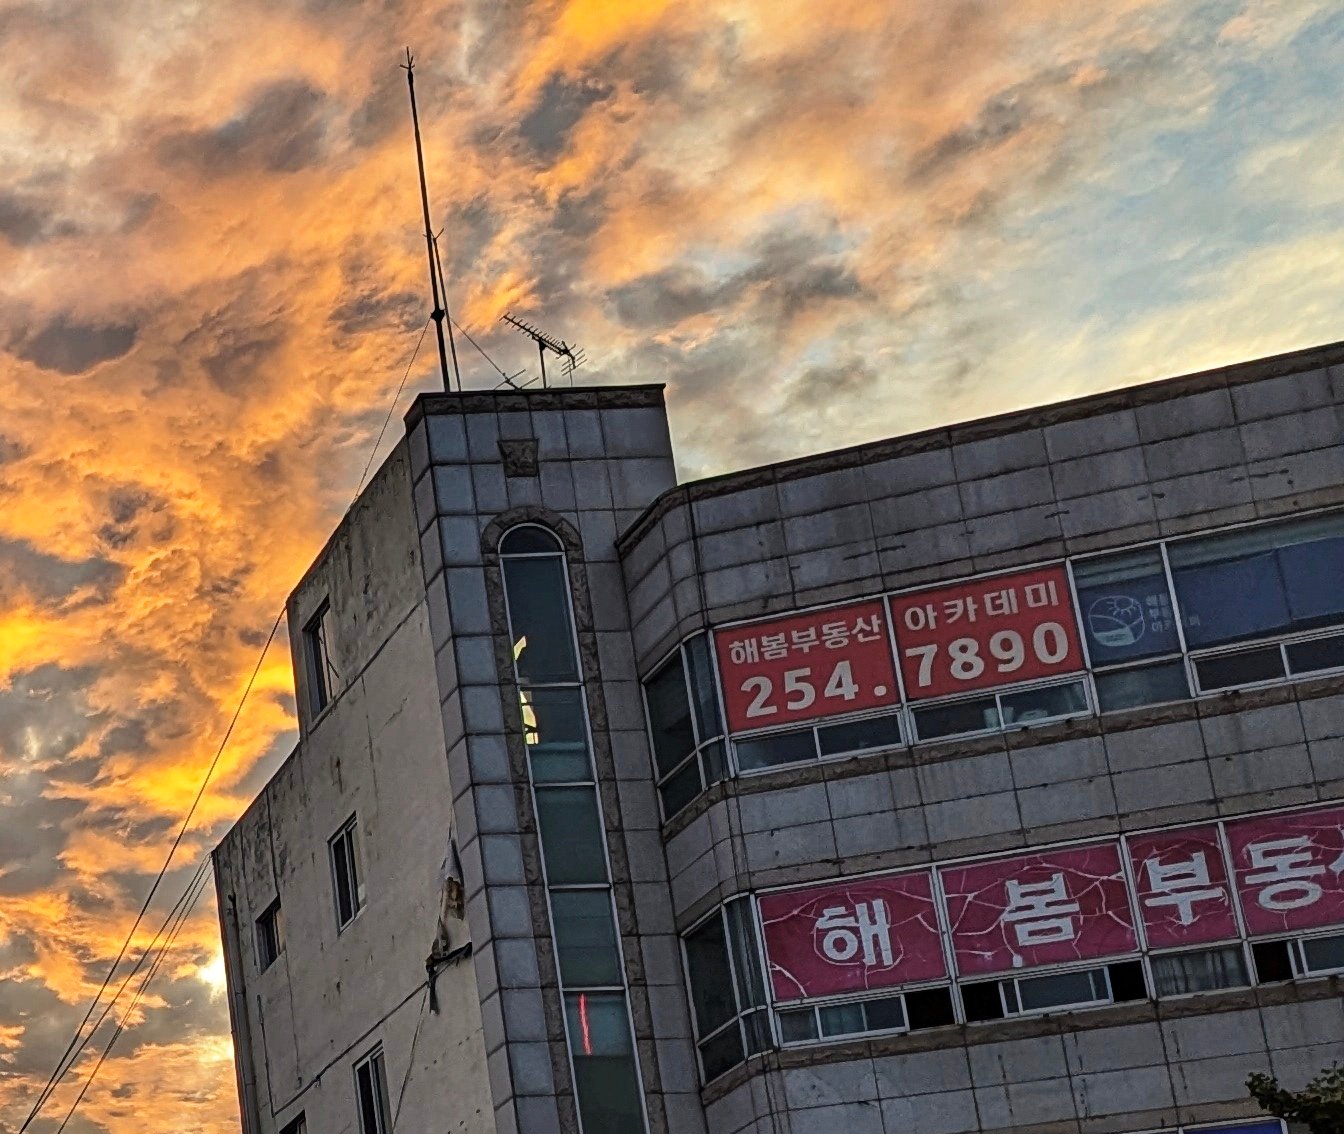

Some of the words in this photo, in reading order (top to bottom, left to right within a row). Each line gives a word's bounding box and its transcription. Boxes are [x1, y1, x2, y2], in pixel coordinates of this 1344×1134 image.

[729, 612, 883, 665] 해봄부동산
[904, 581, 1059, 632] 아카데미
[904, 621, 1070, 689] 7890
[1143, 834, 1344, 928] 부동
